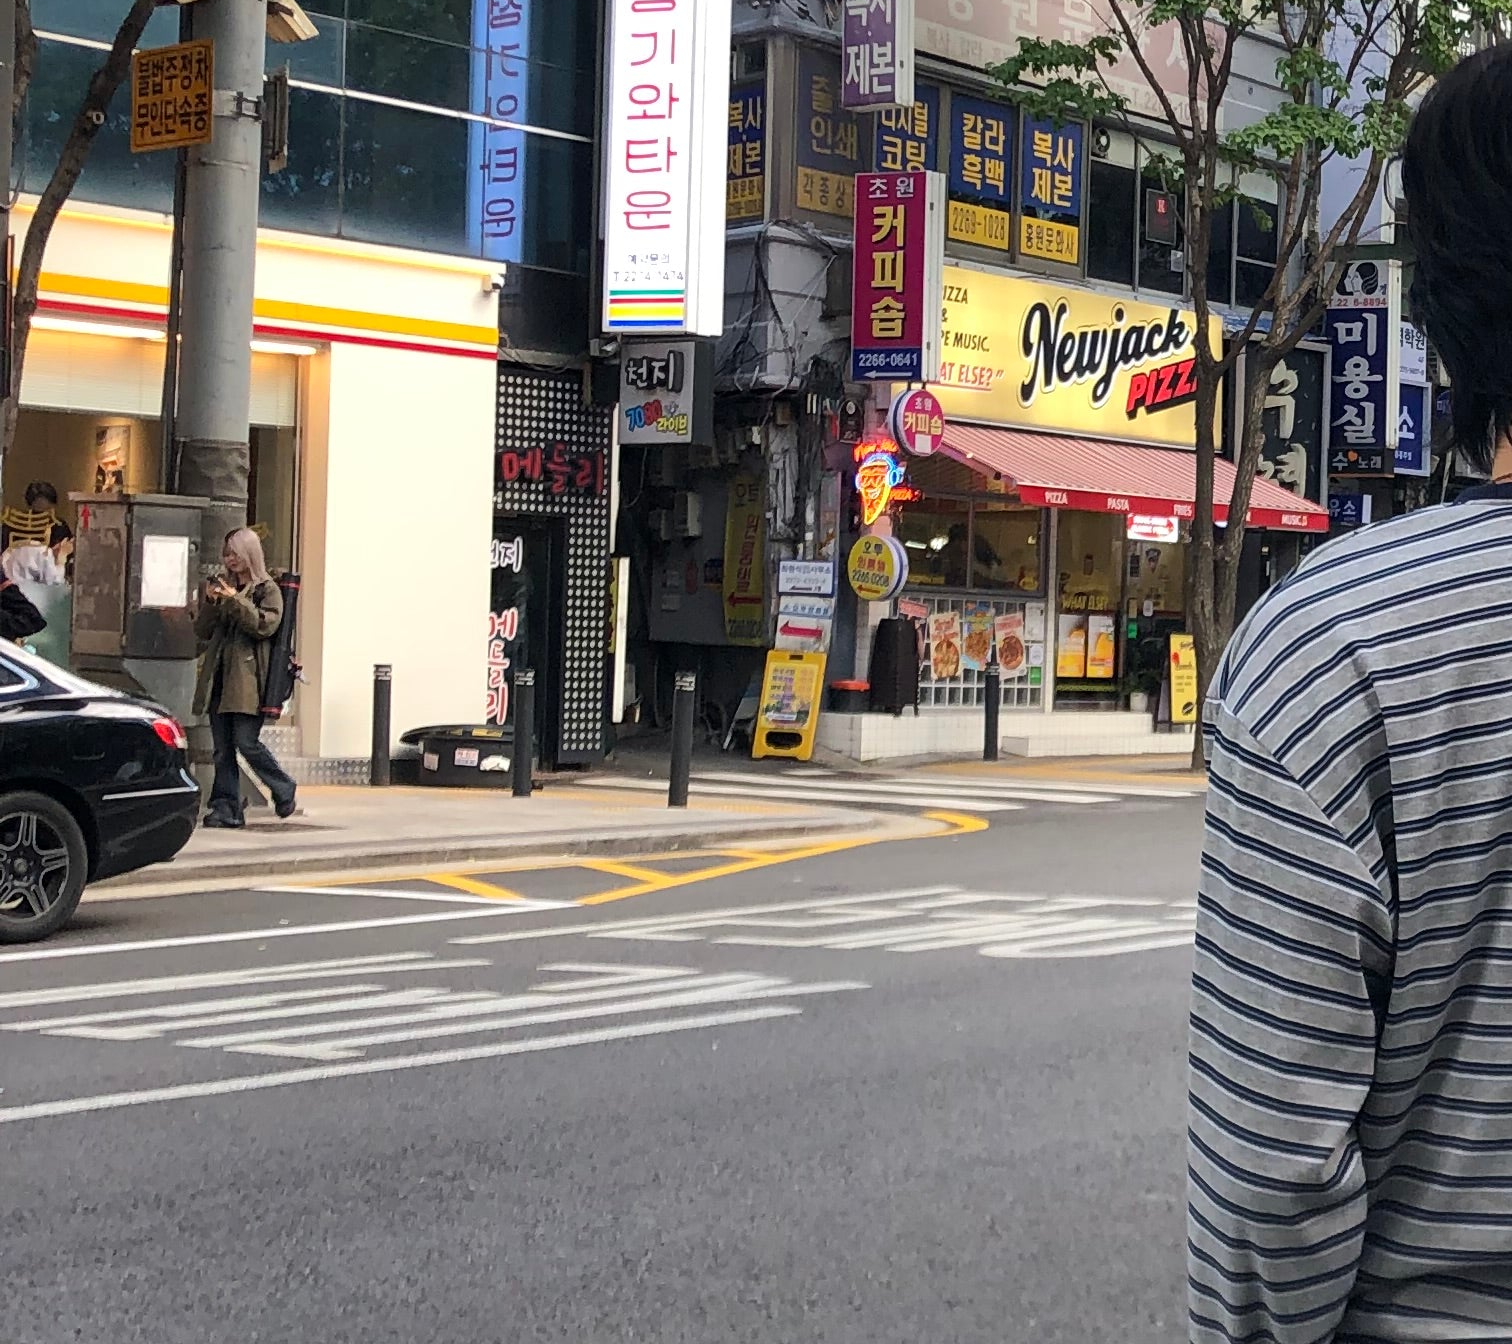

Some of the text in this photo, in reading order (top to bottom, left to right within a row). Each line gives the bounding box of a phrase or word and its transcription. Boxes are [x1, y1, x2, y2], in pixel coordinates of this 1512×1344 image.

[138, 47, 208, 97] 불법주정차
[845, 41, 896, 95] 제본
[135, 92, 208, 140] 무인단속중
[962, 112, 1006, 156] 칼라
[811, 115, 858, 161] 인쇄
[1032, 130, 1075, 173] 복사
[868, 176, 914, 200] 초원
[961, 153, 1005, 196] 흑백
[1031, 167, 1074, 208] 제본
[1025, 222, 1075, 258] 홍원문화사
[870, 204, 907, 340] 커피숍
[943, 285, 969, 305] IZZA
[858, 352, 918, 367] 2266-0641
[939, 361, 955, 381] AT
[1020, 301, 1190, 403] Newjack
[1126, 358, 1198, 418] PIZZ
[1331, 312, 1384, 444] 미용실
[656, 415, 689, 437] 라이브
[904, 411, 943, 436] 커피숍
[501, 441, 604, 494] 메들리
[1044, 491, 1068, 505] PIZZA
[1107, 497, 1130, 512] PASTA
